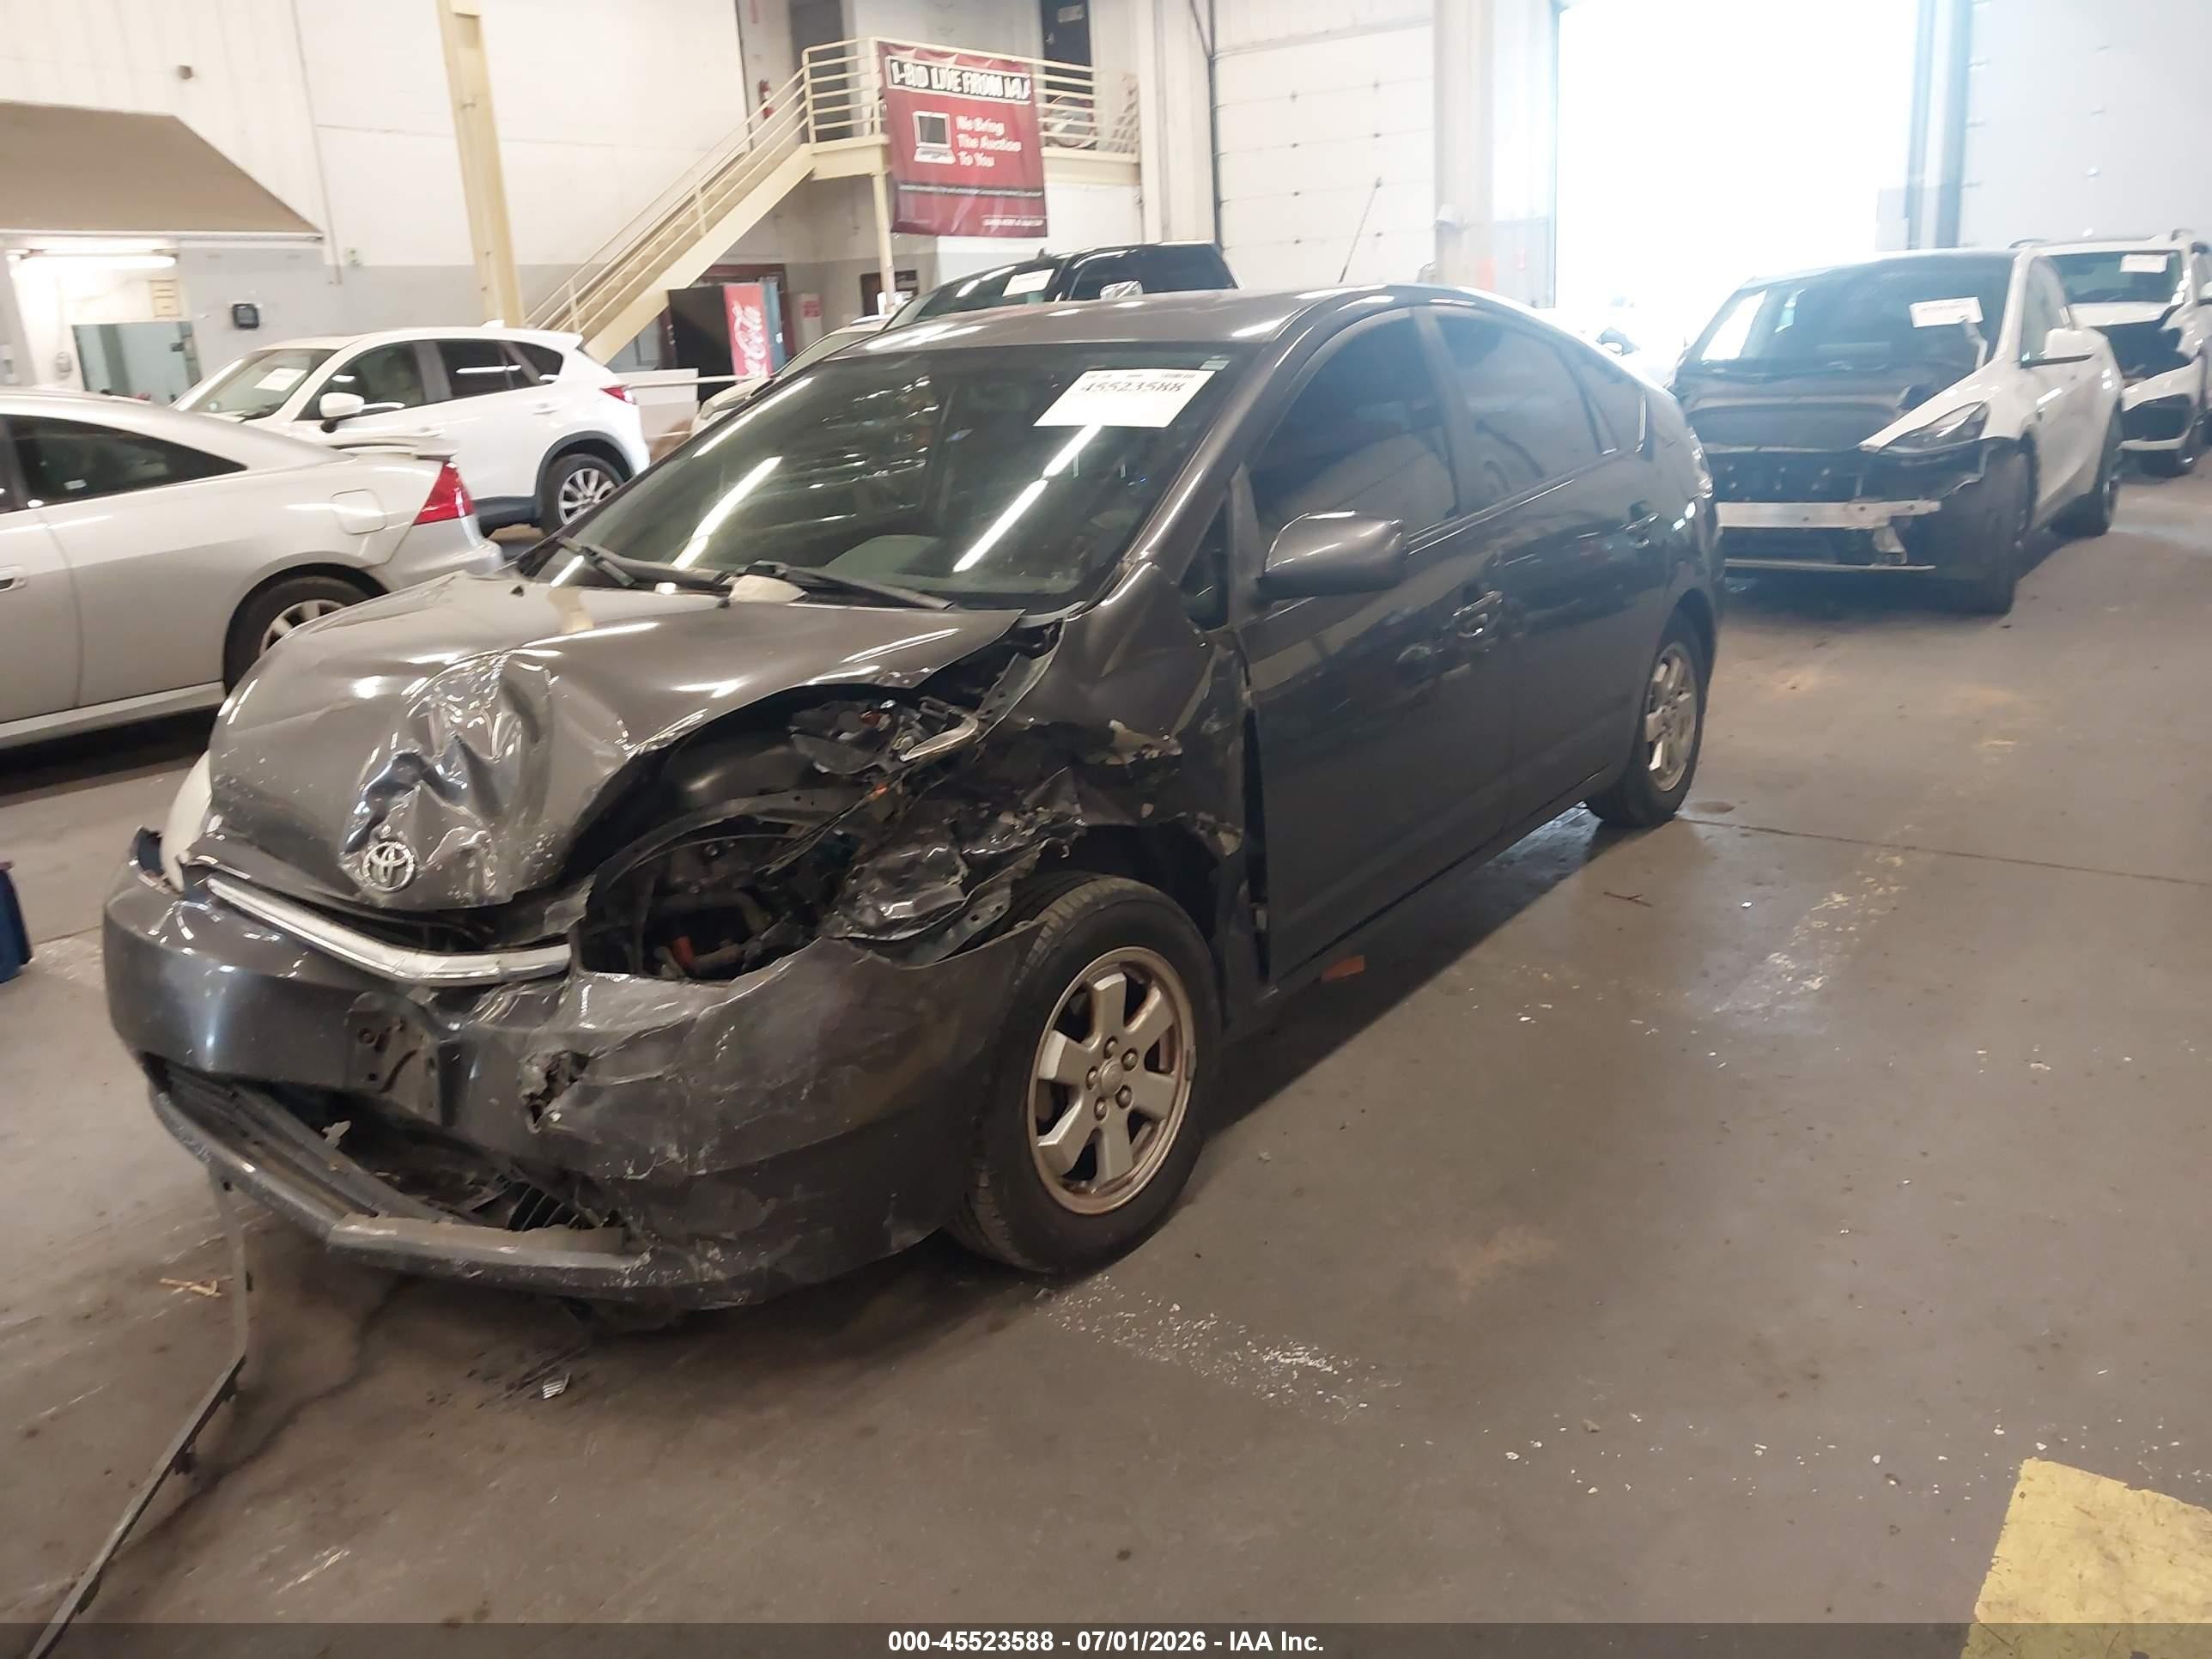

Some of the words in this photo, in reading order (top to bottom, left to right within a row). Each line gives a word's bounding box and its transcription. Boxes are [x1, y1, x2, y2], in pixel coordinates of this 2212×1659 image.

[930, 66, 962, 92] LIVE
[962, 70, 1004, 97] FROM
[956, 115, 974, 131] We
[974, 117, 1004, 137] Bring
[957, 133, 979, 149] The
[980, 136, 1022, 152] Auction
[957, 151, 973, 166] To
[974, 152, 994, 167] You
